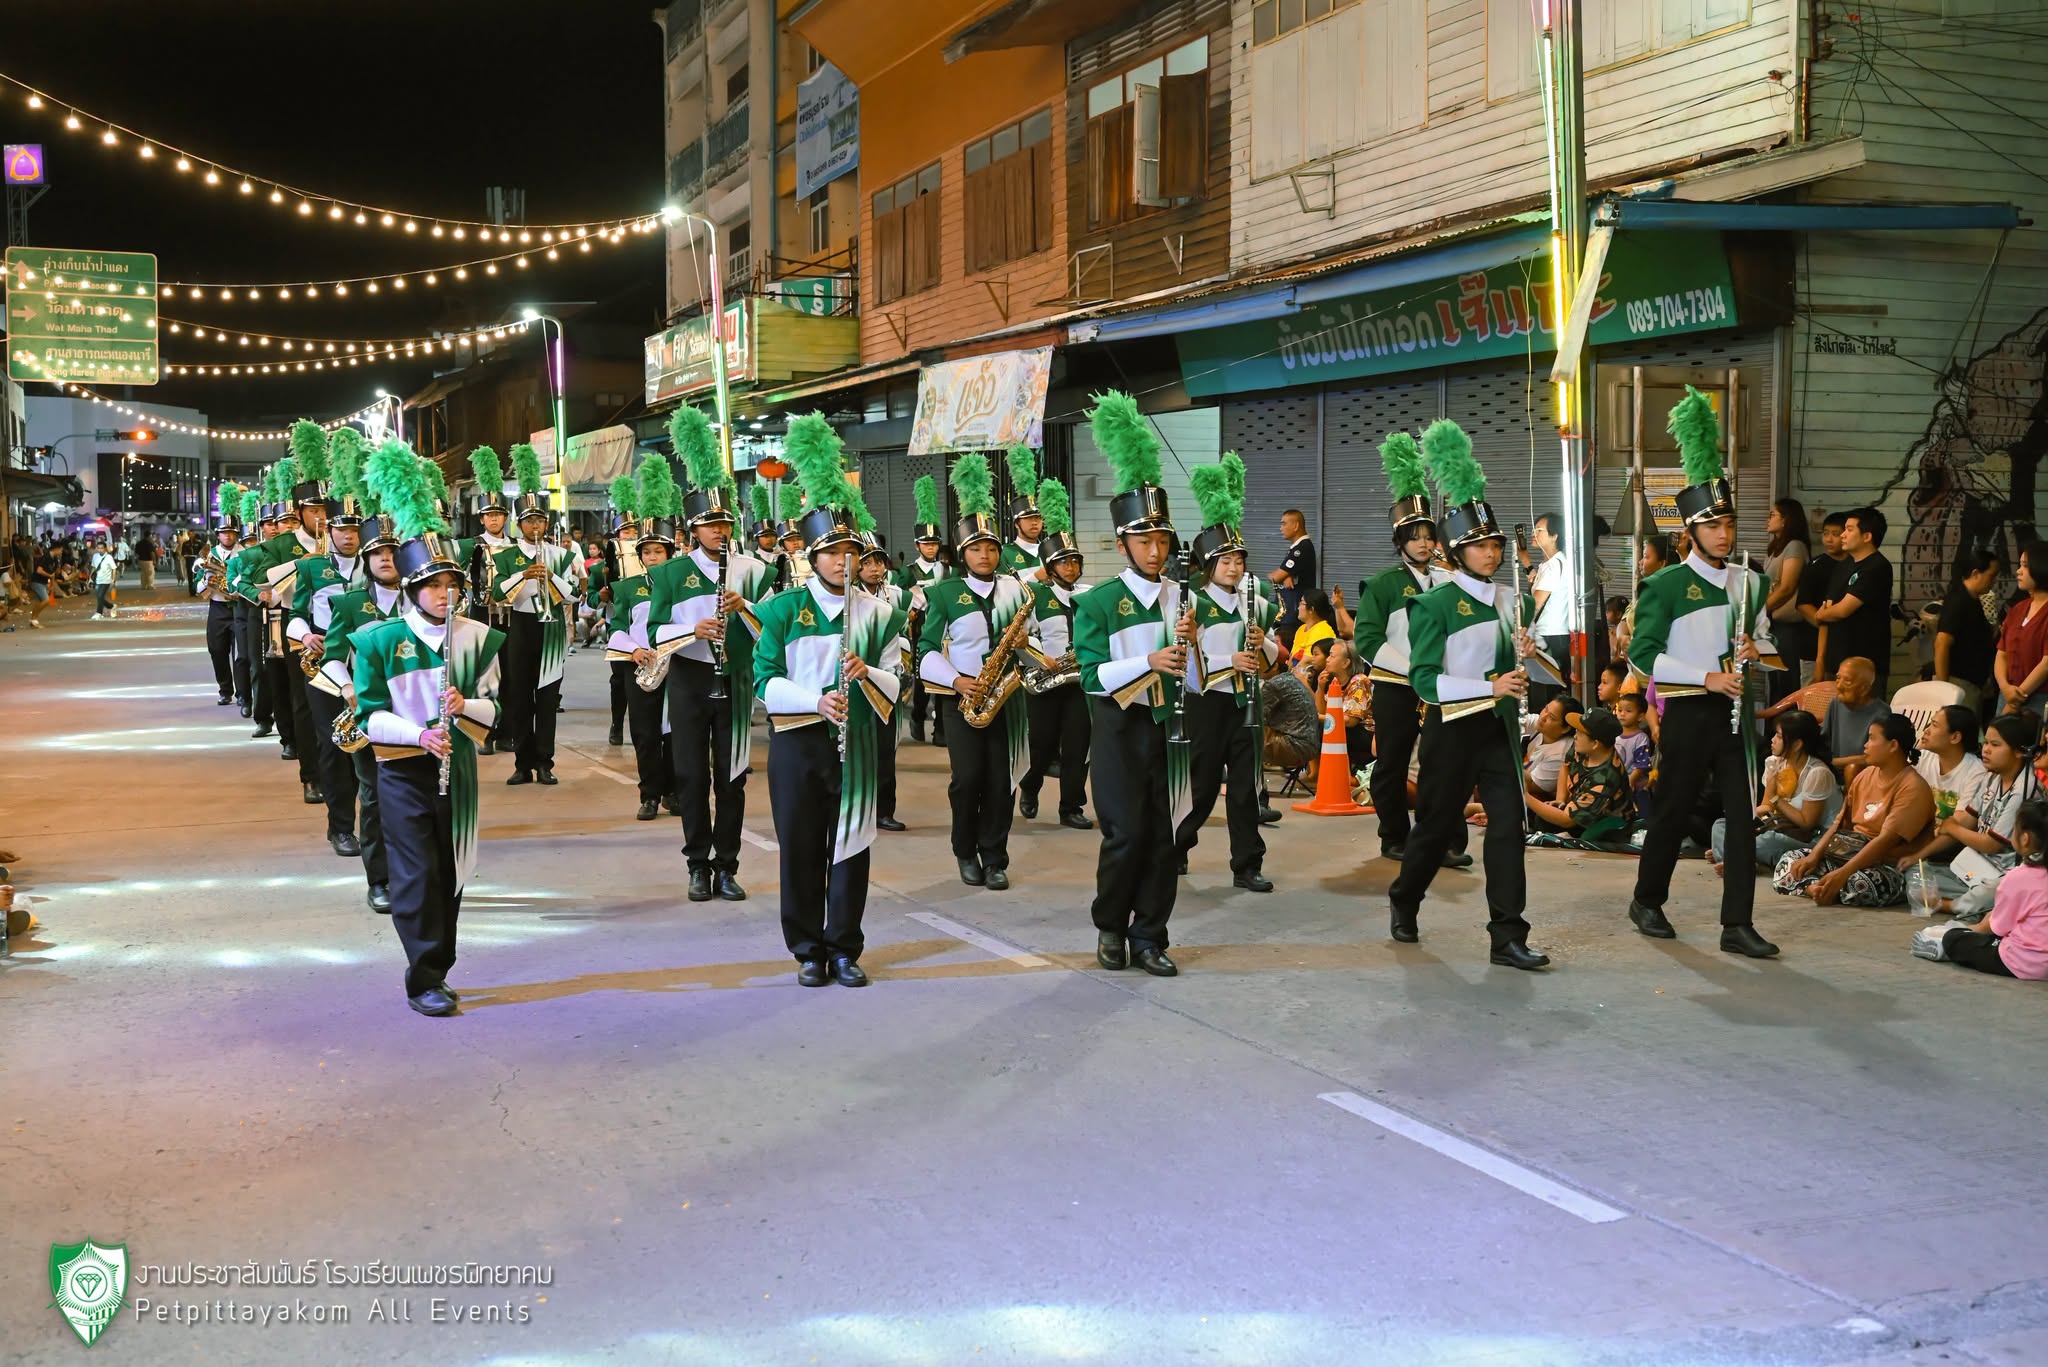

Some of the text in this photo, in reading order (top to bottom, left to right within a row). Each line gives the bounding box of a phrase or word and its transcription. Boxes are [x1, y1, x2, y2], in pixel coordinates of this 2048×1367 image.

[46, 300, 125, 321] วัดมหาาตุ
[1627, 285, 1727, 334] 089-704-7304
[46, 323, 118, 334] Wat Maha Thad
[1278, 303, 1437, 370] ข้าวมันไก่ทอด
